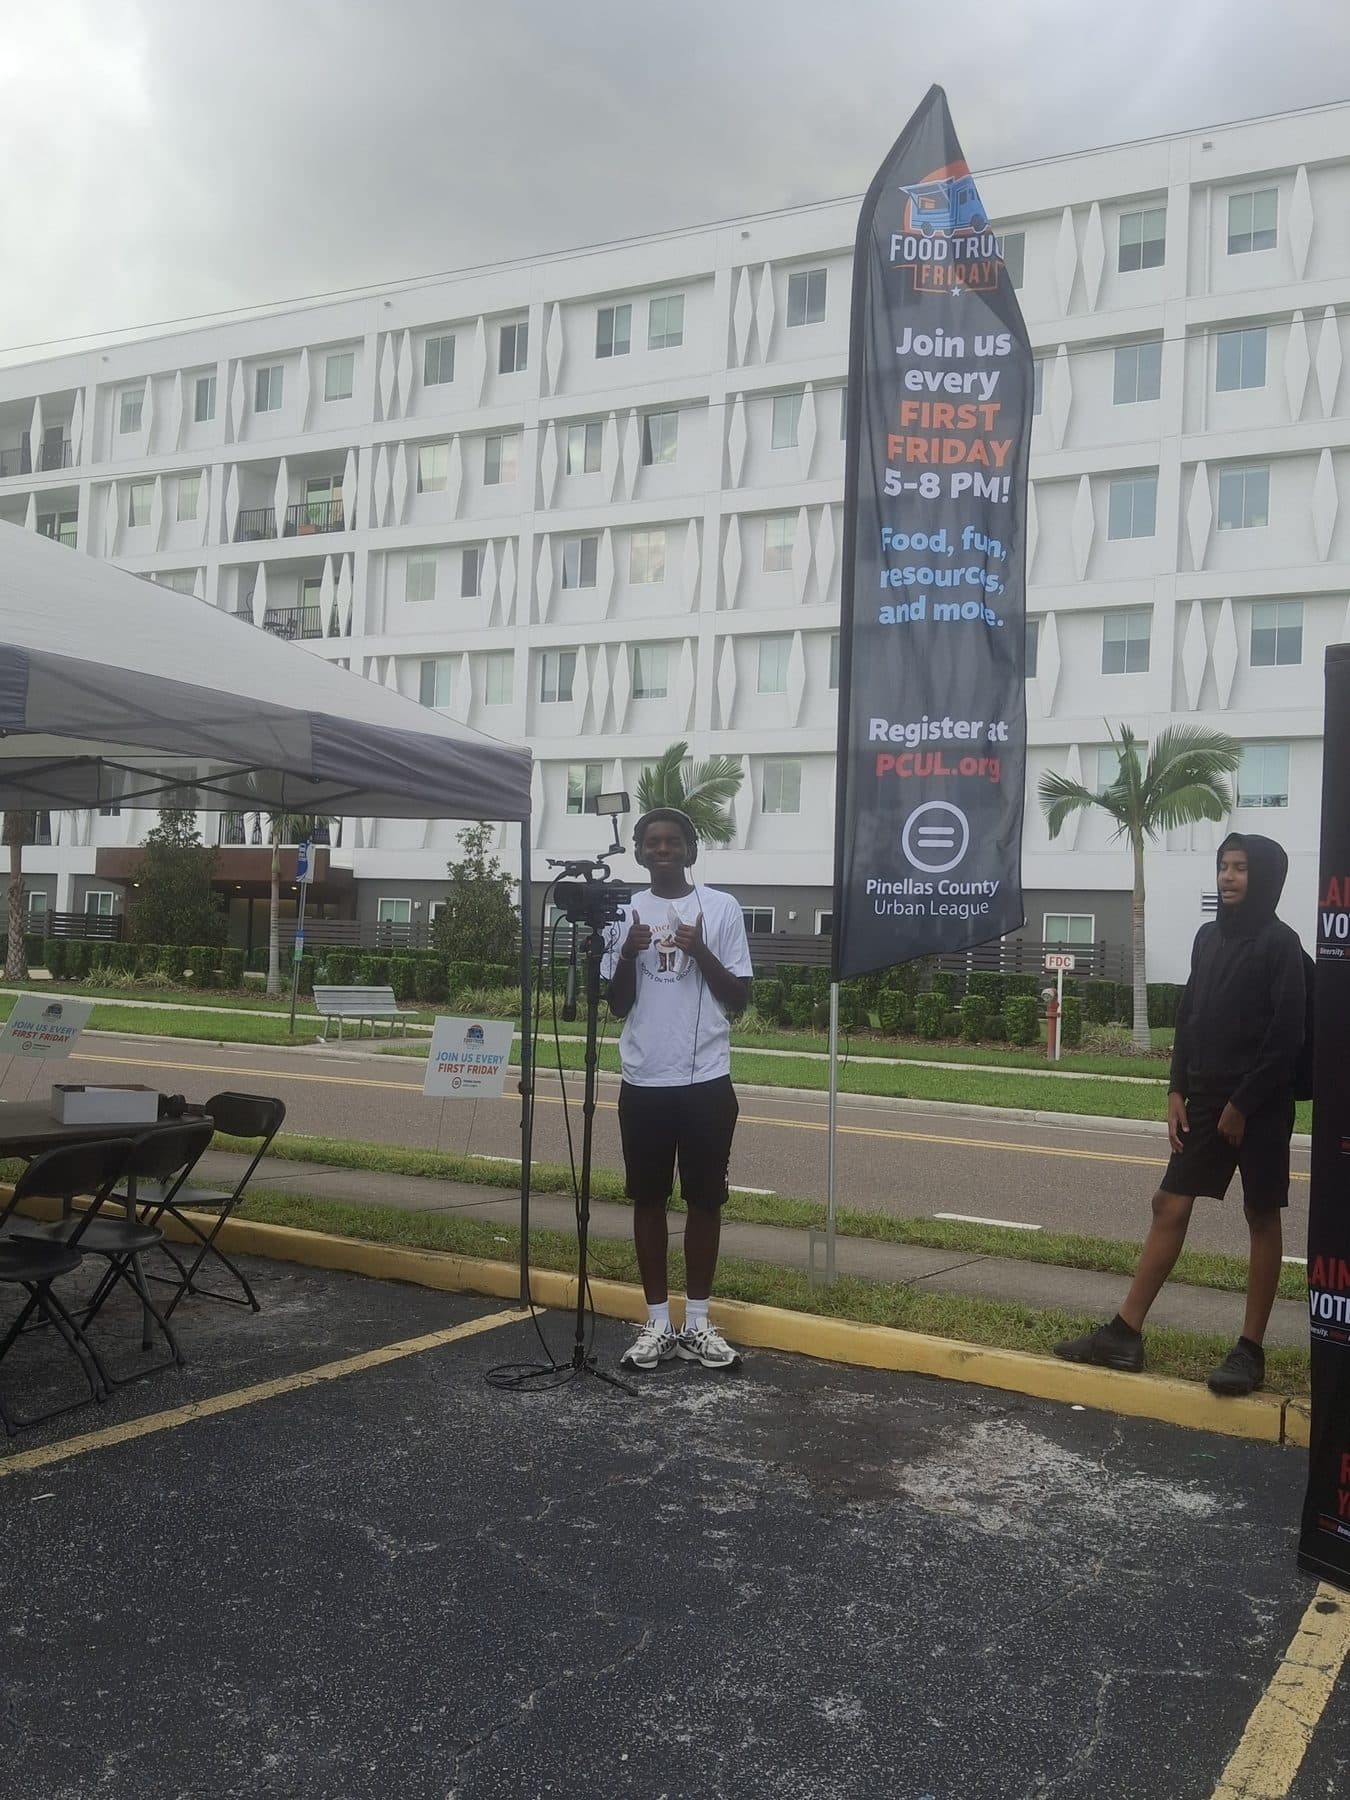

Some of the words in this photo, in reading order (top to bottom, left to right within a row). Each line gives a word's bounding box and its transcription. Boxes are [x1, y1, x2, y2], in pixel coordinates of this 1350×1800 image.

[889, 234, 948, 261] FOOD
[921, 262, 991, 286] FRIDAY
[895, 327, 965, 358] Join
[974, 332, 1012, 356] us
[904, 368, 1001, 401] every
[900, 400, 1001, 432] FIRST
[887, 433, 1013, 468] FRIDAY
[883, 467, 941, 499] 5-8
[950, 471, 1011, 504] PM!
[880, 527, 954, 558] Food,
[962, 525, 1007, 562] fun,
[878, 595, 926, 625] and
[868, 715, 984, 748] Register
[987, 721, 1009, 742] at
[875, 751, 1001, 784] PCUL.org
[866, 878, 933, 895] Pinellas
[938, 879, 1000, 902] County
[874, 900, 925, 915] Urban
[930, 900, 989, 920] League
[1322, 912, 1350, 939] VO
[1049, 956, 1071, 967] FDC
[12, 1021, 34, 1029] JOIN
[36, 1023, 47, 1032] US
[12, 1030, 38, 1039] FIRST
[39, 1033, 70, 1042] FRIDAY
[435, 1051, 459, 1062] JOIN
[461, 1053, 473, 1063] US
[476, 1054, 504, 1065] EVERY
[438, 1063, 465, 1073] FIRST
[466, 1064, 499, 1075] FRIDAY
